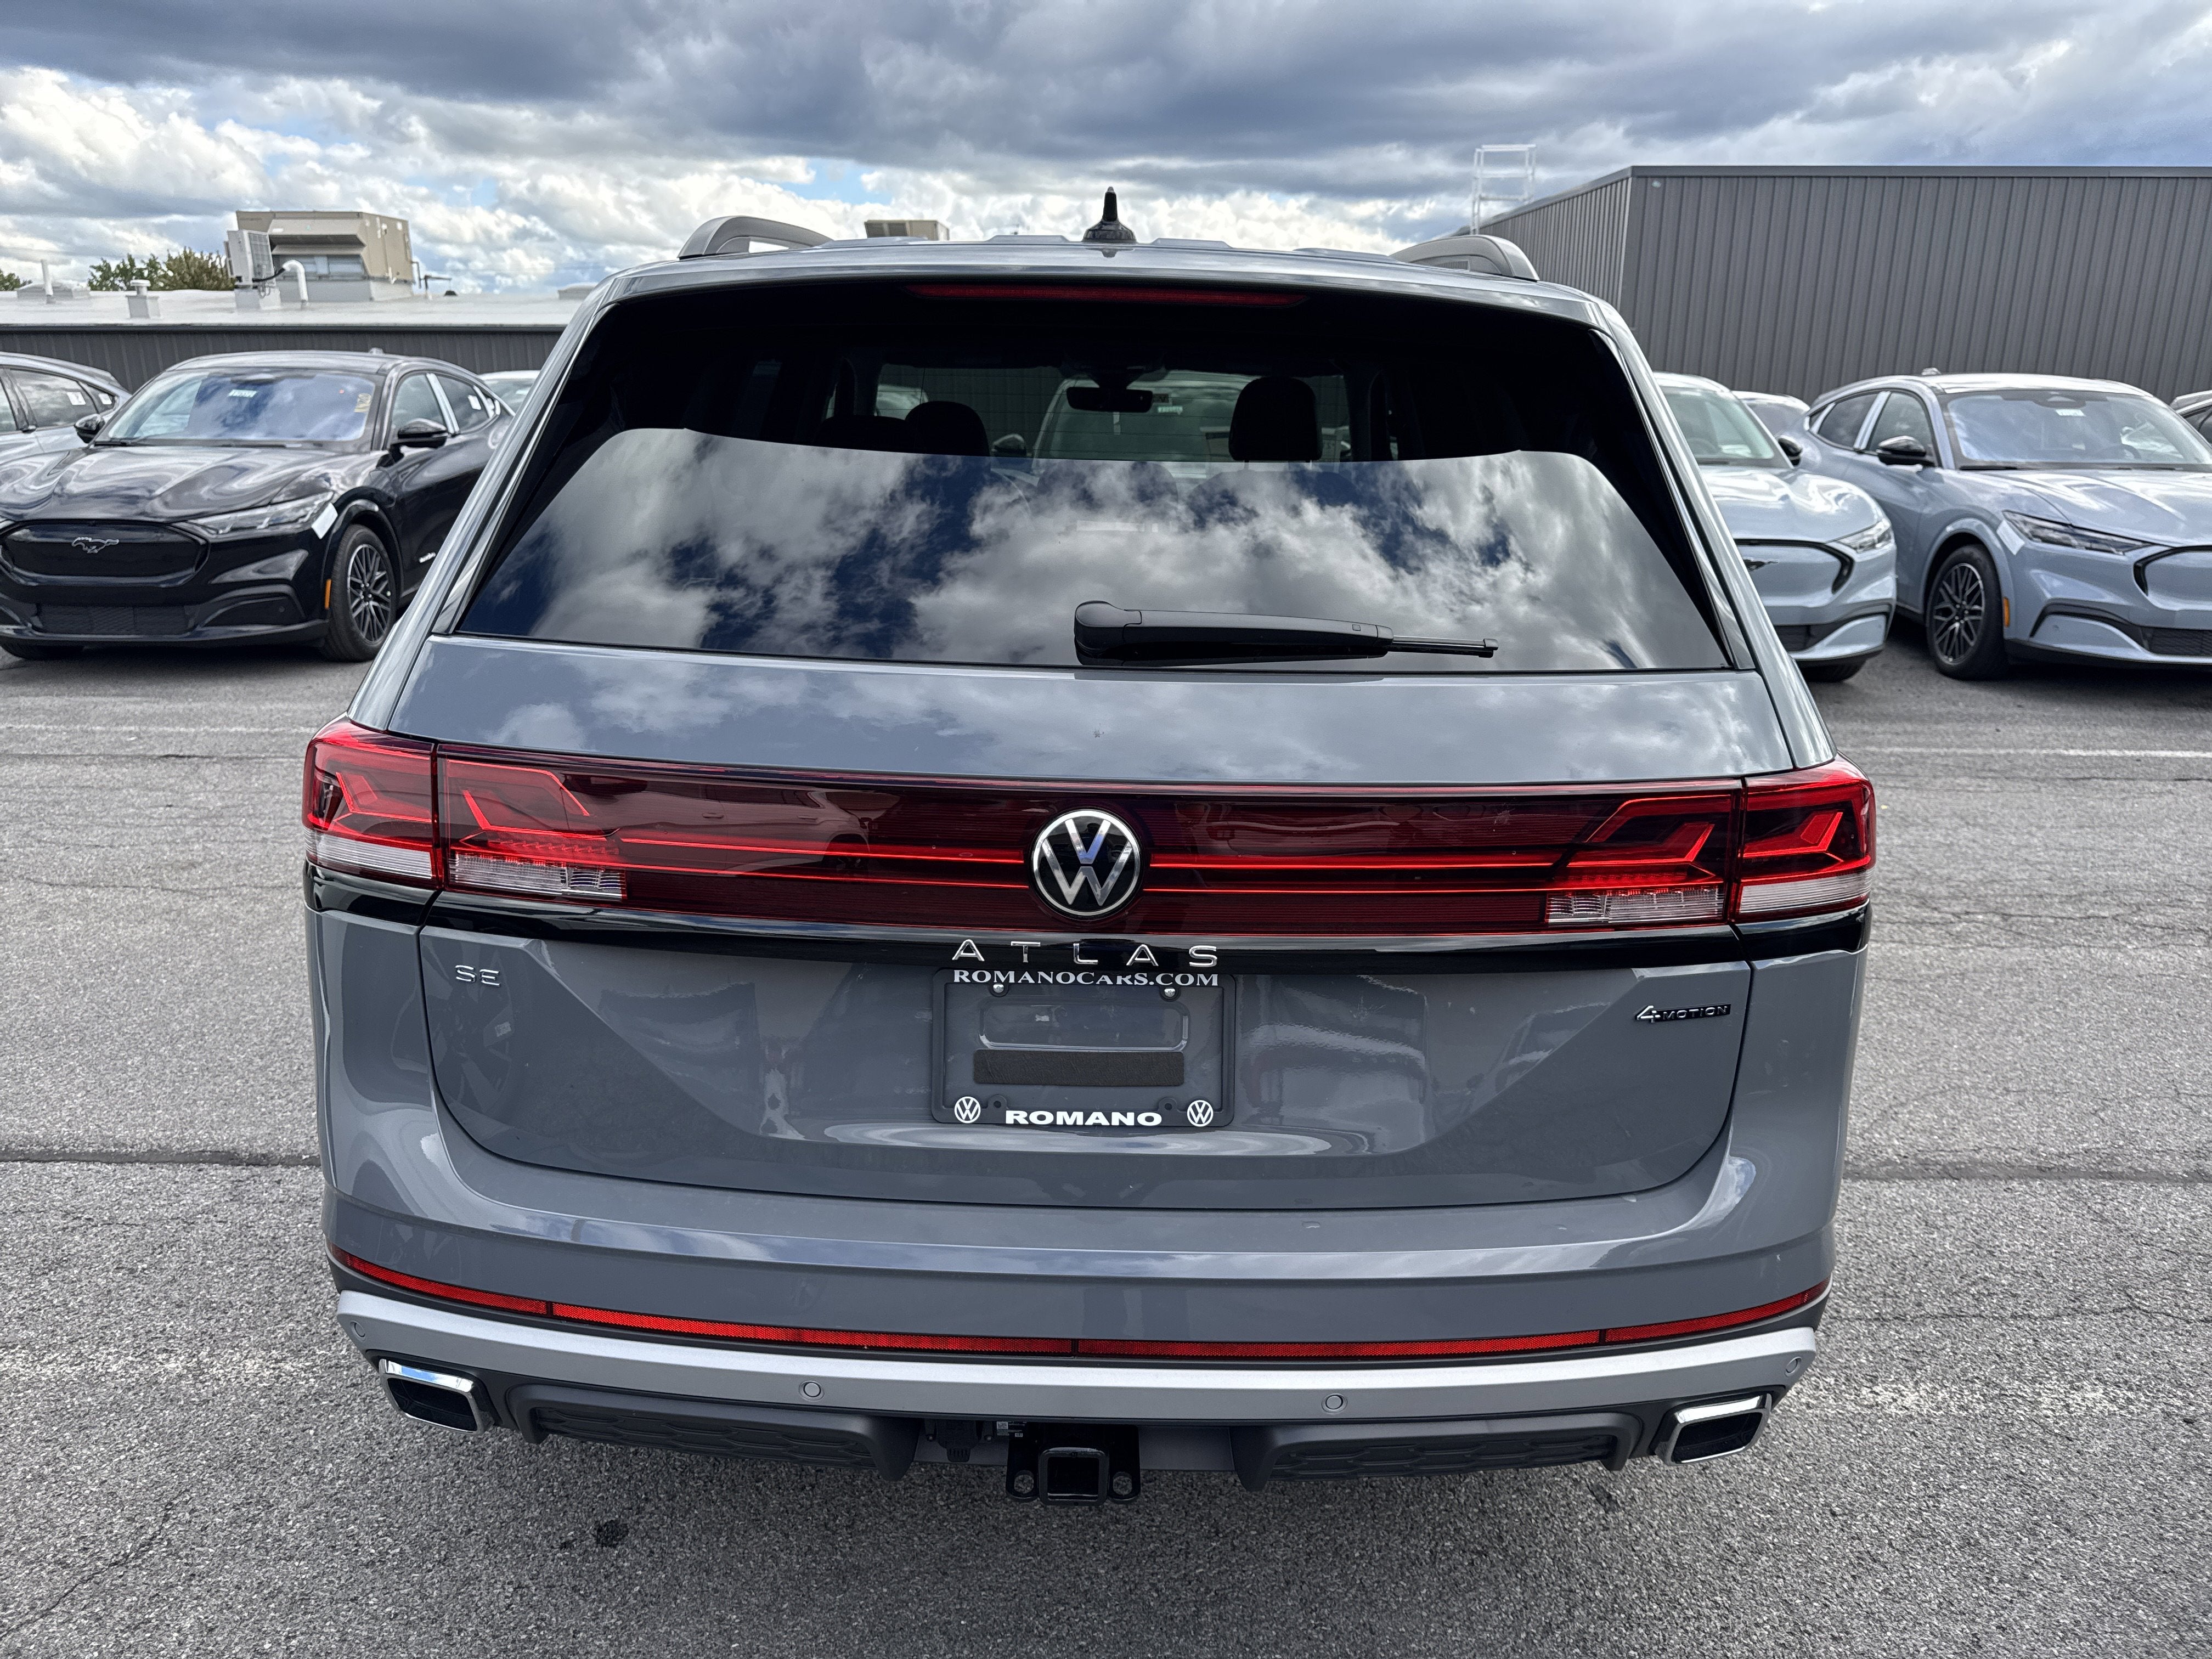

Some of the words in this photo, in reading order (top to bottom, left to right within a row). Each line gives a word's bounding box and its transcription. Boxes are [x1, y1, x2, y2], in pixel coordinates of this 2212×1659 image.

[951, 939, 1218, 968] ATLAS
[455, 964, 501, 988] SE
[952, 969, 1219, 987] ROMANOCARS.COM
[1005, 1110, 1163, 1127] ROMANO
